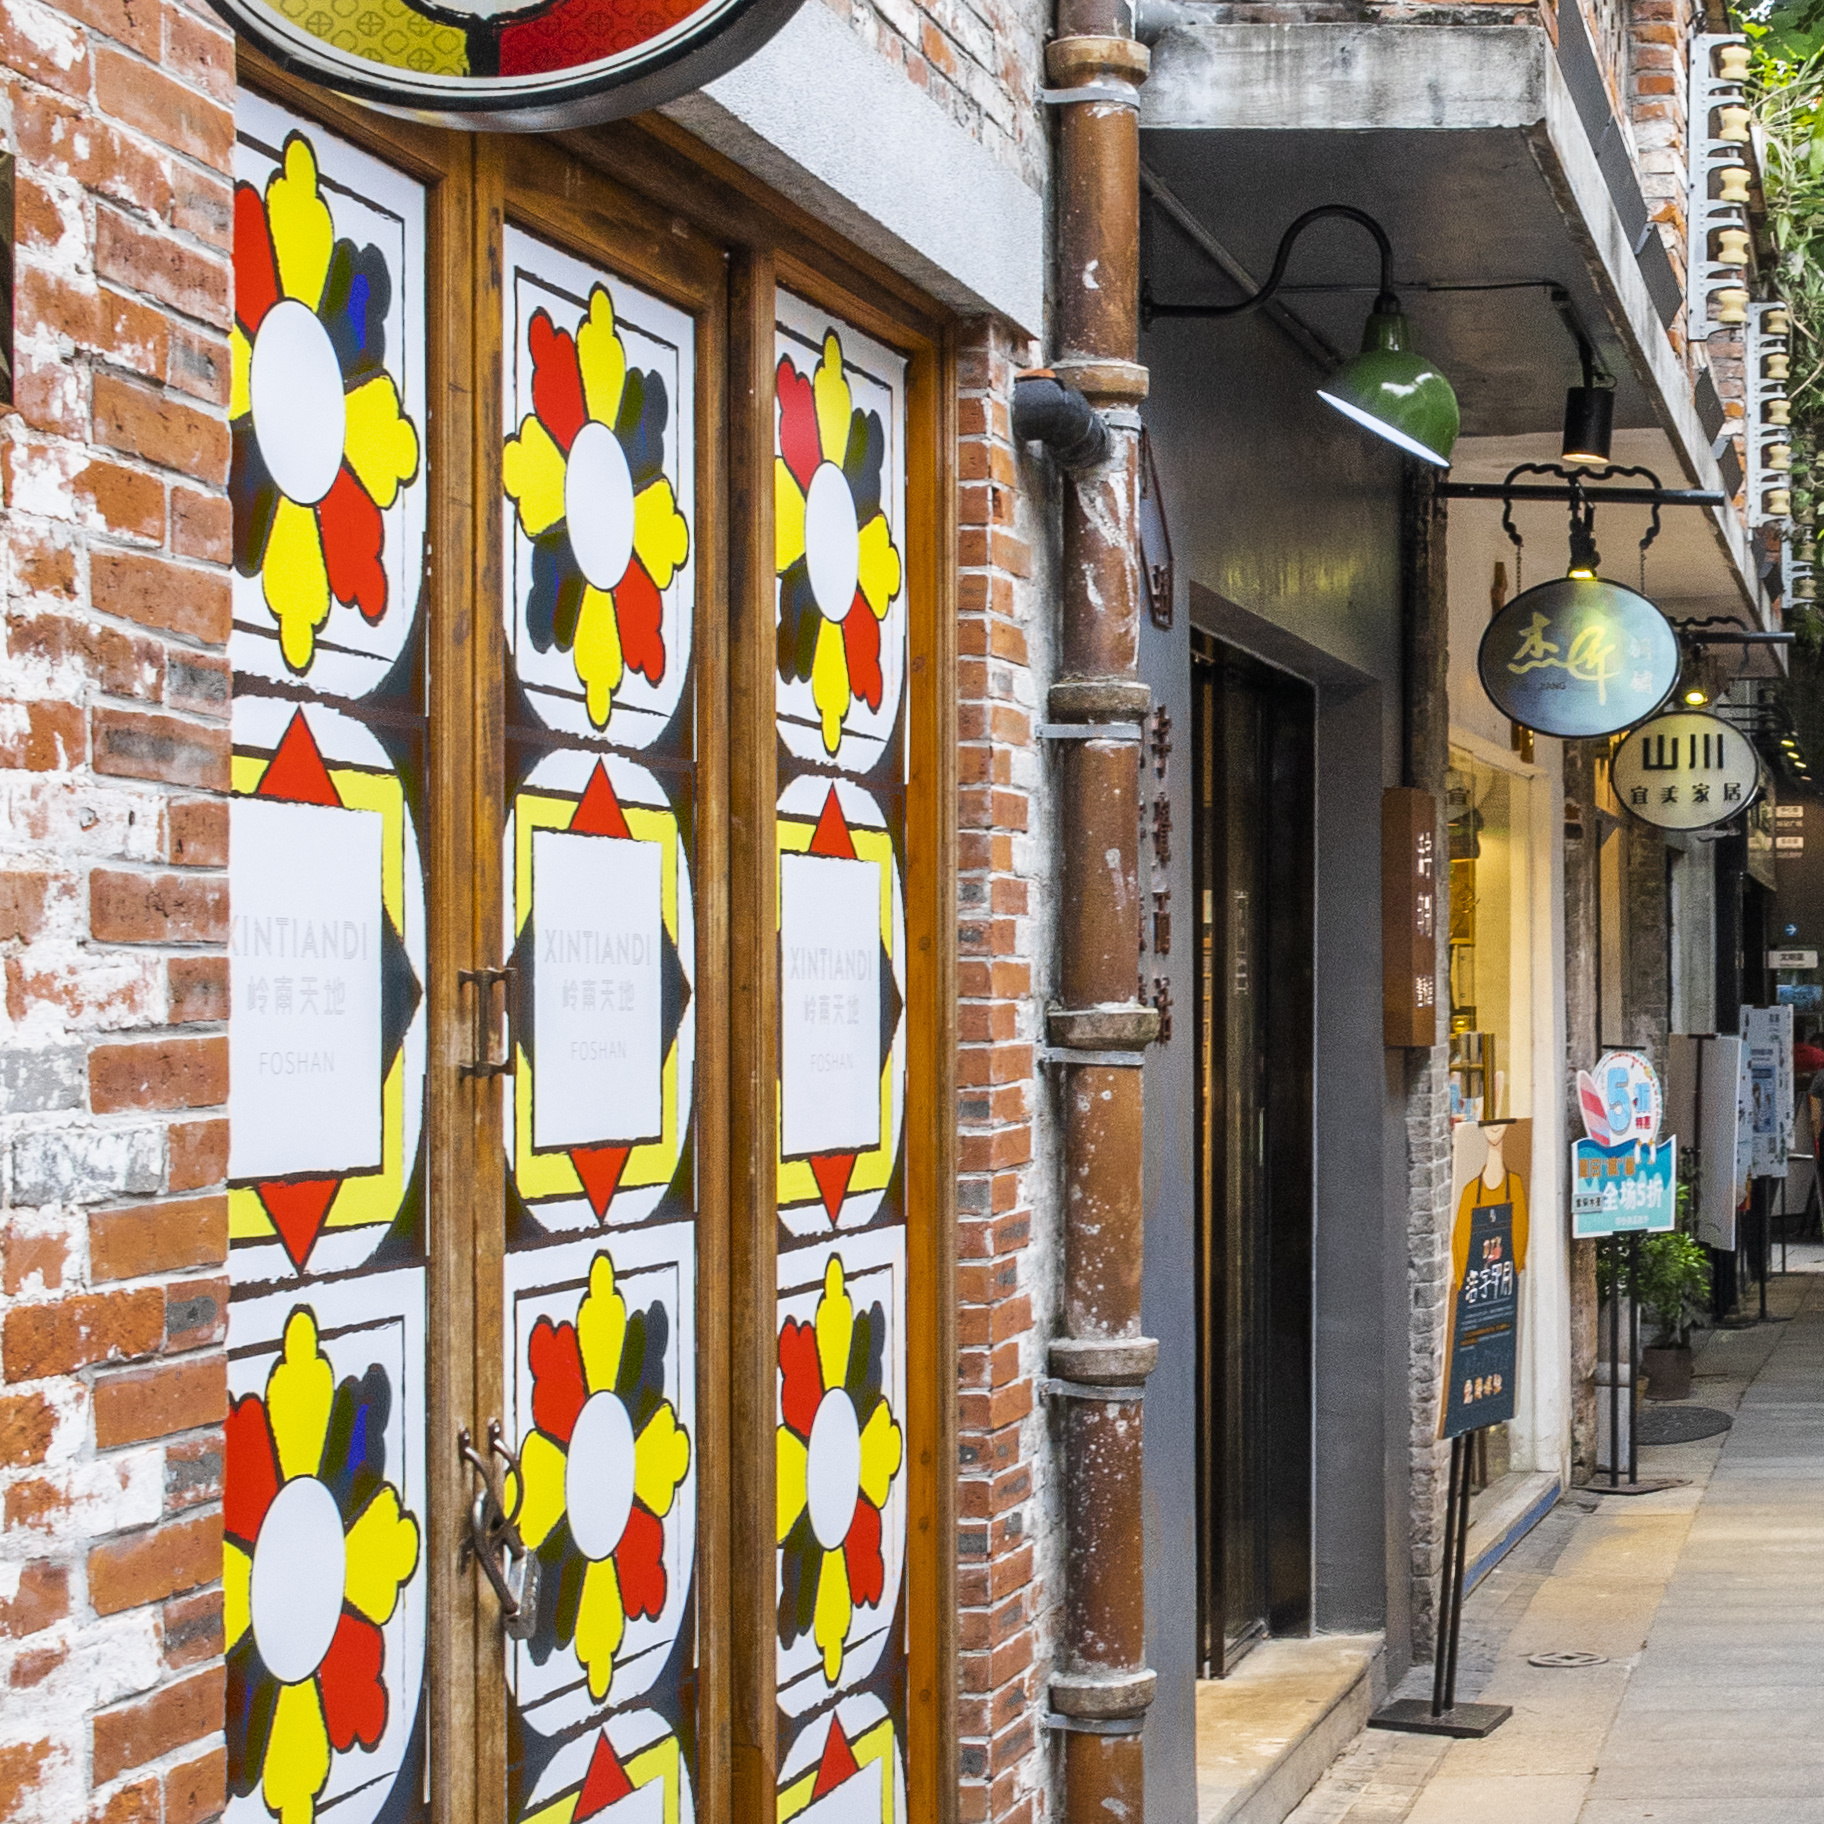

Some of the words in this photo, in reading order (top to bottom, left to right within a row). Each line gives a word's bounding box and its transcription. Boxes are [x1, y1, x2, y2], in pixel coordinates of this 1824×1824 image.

[1643, 733, 1724, 770] 山川
[1631, 782, 1742, 805] 宜美家居
[544, 929, 651, 966] XINTIANDI
[789, 947, 872, 981] XINTIANDI
[247, 975, 346, 1016] 岭南天地
[561, 979, 635, 1013] 岭南天地
[803, 995, 860, 1026] 岭南天地
[258, 1051, 336, 1076] FOSHAN
[570, 1041, 627, 1062] FOSHAN
[1603, 1179, 1664, 1211] 全场5折
